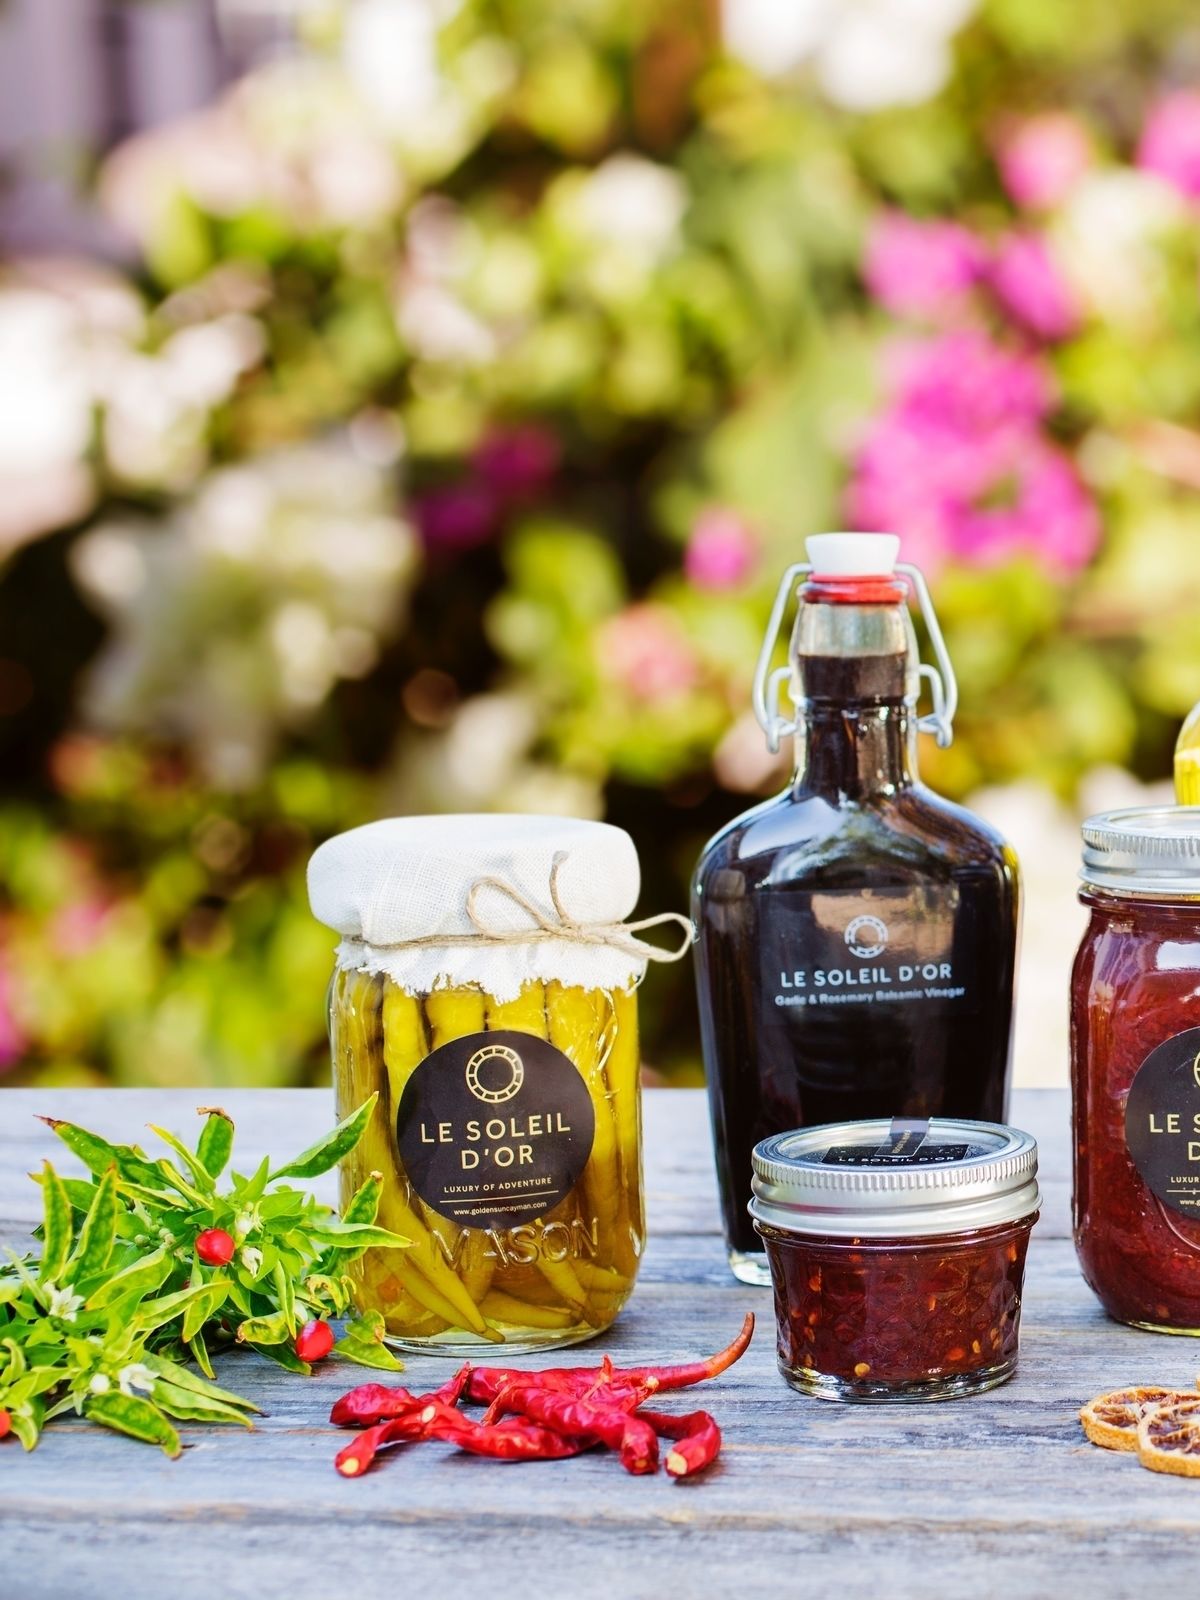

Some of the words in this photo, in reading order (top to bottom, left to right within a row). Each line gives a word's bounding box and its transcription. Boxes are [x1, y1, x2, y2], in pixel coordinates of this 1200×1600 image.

[780, 971, 807, 988] LE
[814, 967, 892, 988] SOLEIL
[898, 963, 953, 983] D'OR
[808, 994, 818, 1005] &
[819, 993, 874, 1004] Rosemary
[875, 989, 923, 1001] Balsamic
[925, 987, 965, 999] Vinegar
[420, 1122, 453, 1143] LE
[466, 1112, 571, 1142] SOLEIL
[1149, 1113, 1181, 1133] LE
[461, 1144, 534, 1170] D'OR
[443, 1184, 480, 1194] LUXURY
[483, 1182, 495, 1191] OF
[498, 1177, 552, 1190] ADVENTURE
[453, 1200, 548, 1216] www.goldensuncayman.com
